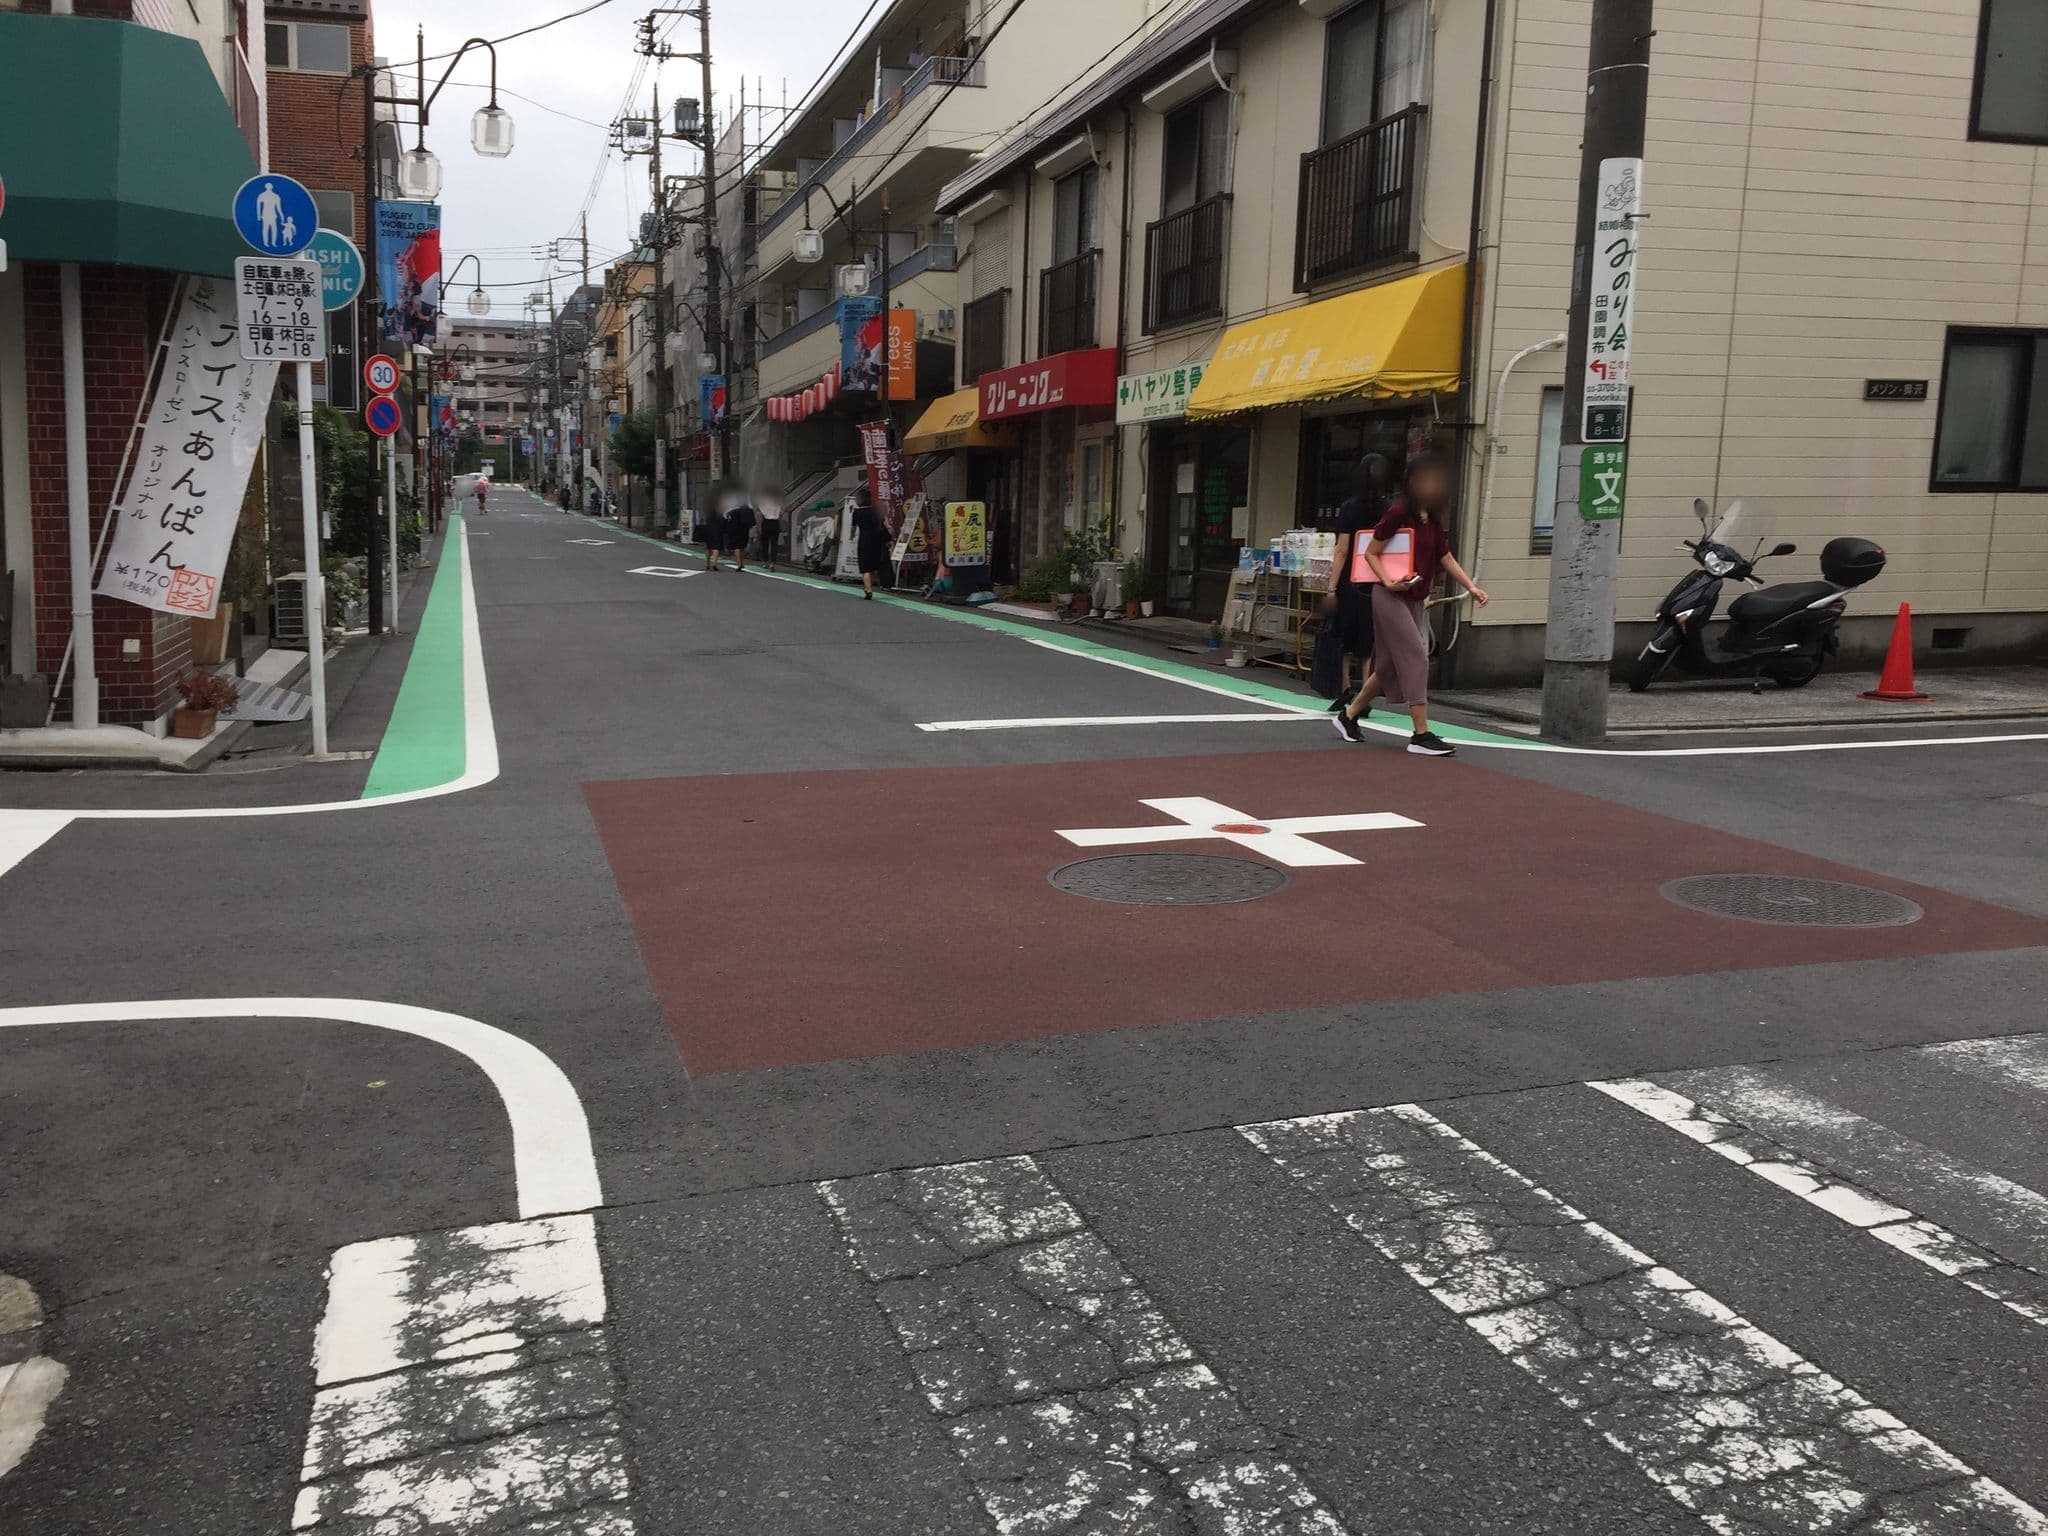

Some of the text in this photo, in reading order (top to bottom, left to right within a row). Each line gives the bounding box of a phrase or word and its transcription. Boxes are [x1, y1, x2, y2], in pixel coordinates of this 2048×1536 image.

[243, 264, 315, 281] 自転車を除く
[1605, 238, 1637, 350] みのり会
[1591, 295, 1608, 354] 田園調布
[161, 324, 202, 424] ハンスローゼン
[373, 366, 393, 383] 30
[903, 340, 913, 370] HAIR
[986, 370, 1051, 415] クリーニング
[130, 443, 169, 520] オリジナル
[1591, 467, 1622, 506] 文
